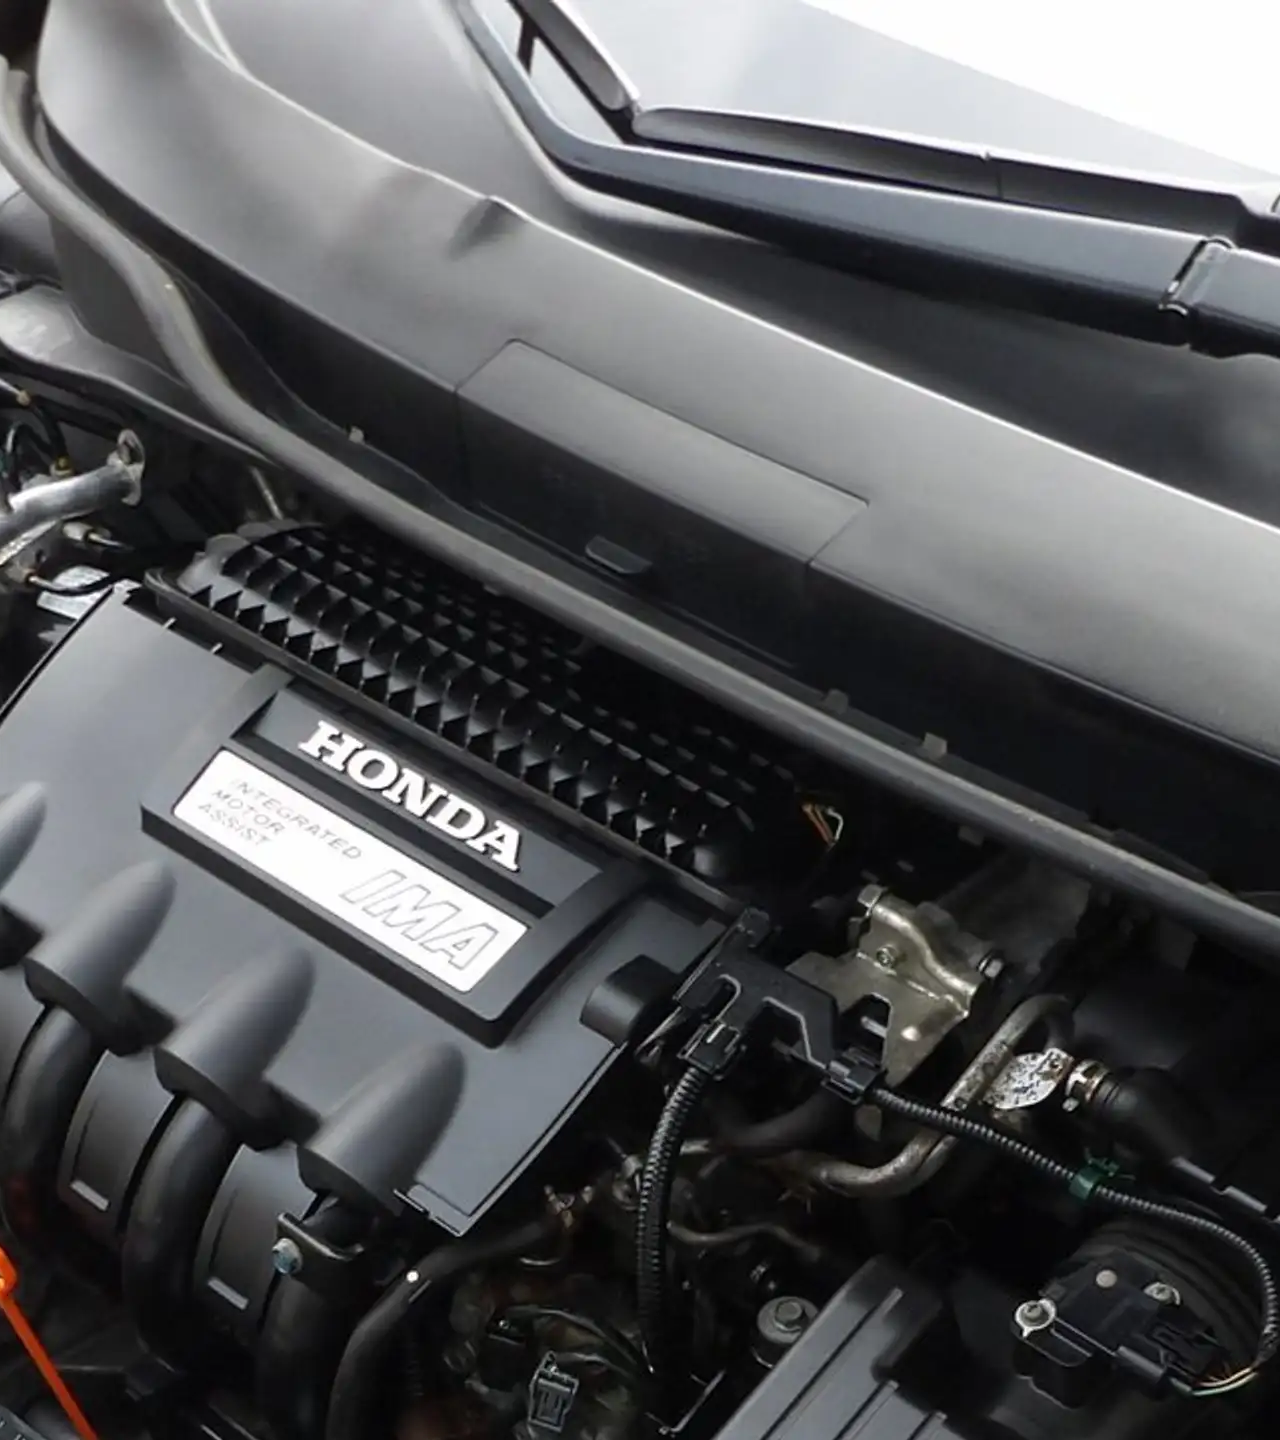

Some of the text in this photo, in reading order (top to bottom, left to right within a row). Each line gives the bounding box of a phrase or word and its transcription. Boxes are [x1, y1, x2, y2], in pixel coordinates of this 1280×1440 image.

[198, 801, 276, 848] ASSIST
[212, 788, 287, 836] MOTOR
[230, 777, 362, 861] INTEGRATED
[298, 720, 521, 873] HONDA
[340, 868, 498, 971] IMA
